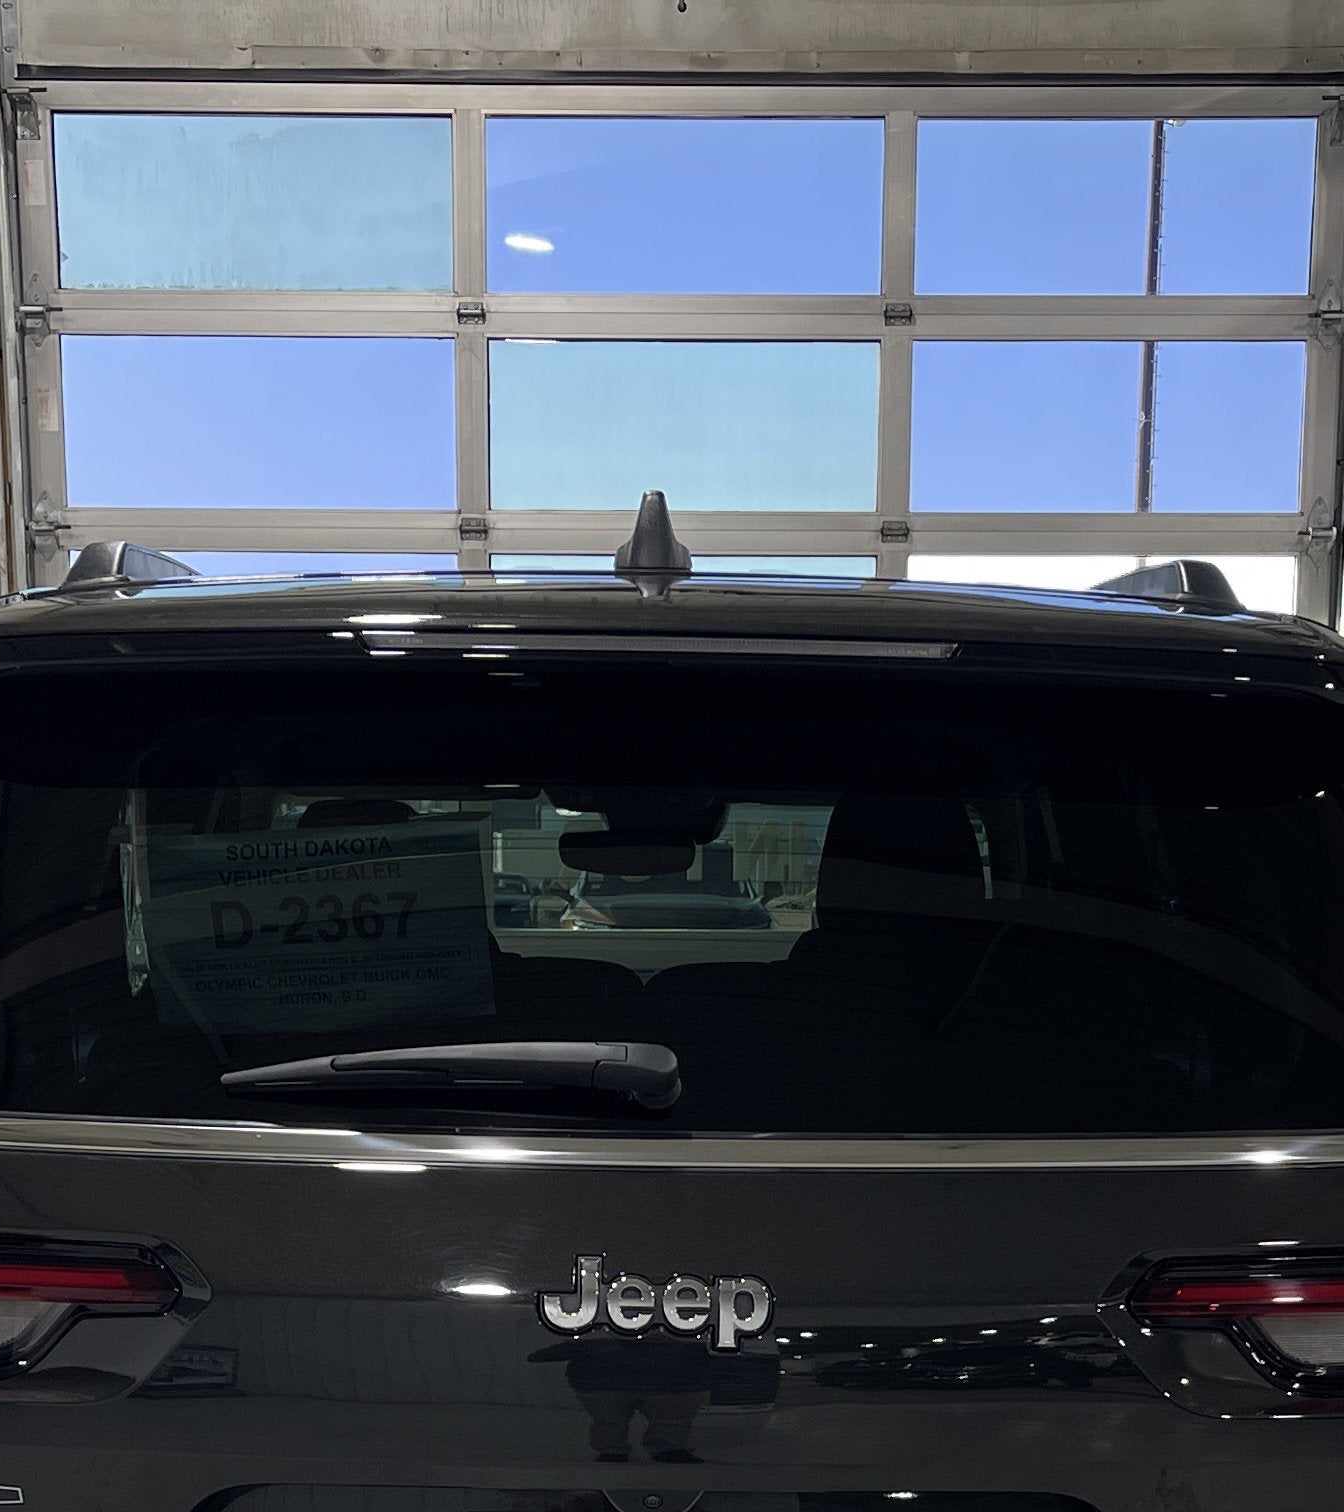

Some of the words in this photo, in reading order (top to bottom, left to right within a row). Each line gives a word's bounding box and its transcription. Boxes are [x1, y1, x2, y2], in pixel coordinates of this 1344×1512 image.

[225, 840, 298, 861] SOUTH
[305, 835, 392, 859] DAKOTA
[218, 866, 311, 888] VEHICLE
[315, 860, 401, 884] DEALER
[209, 891, 420, 950] D-2367
[195, 975, 264, 994] OLYMPIC
[268, 970, 361, 991] CHEVROLET
[540, 1255, 770, 1348] Jeep
